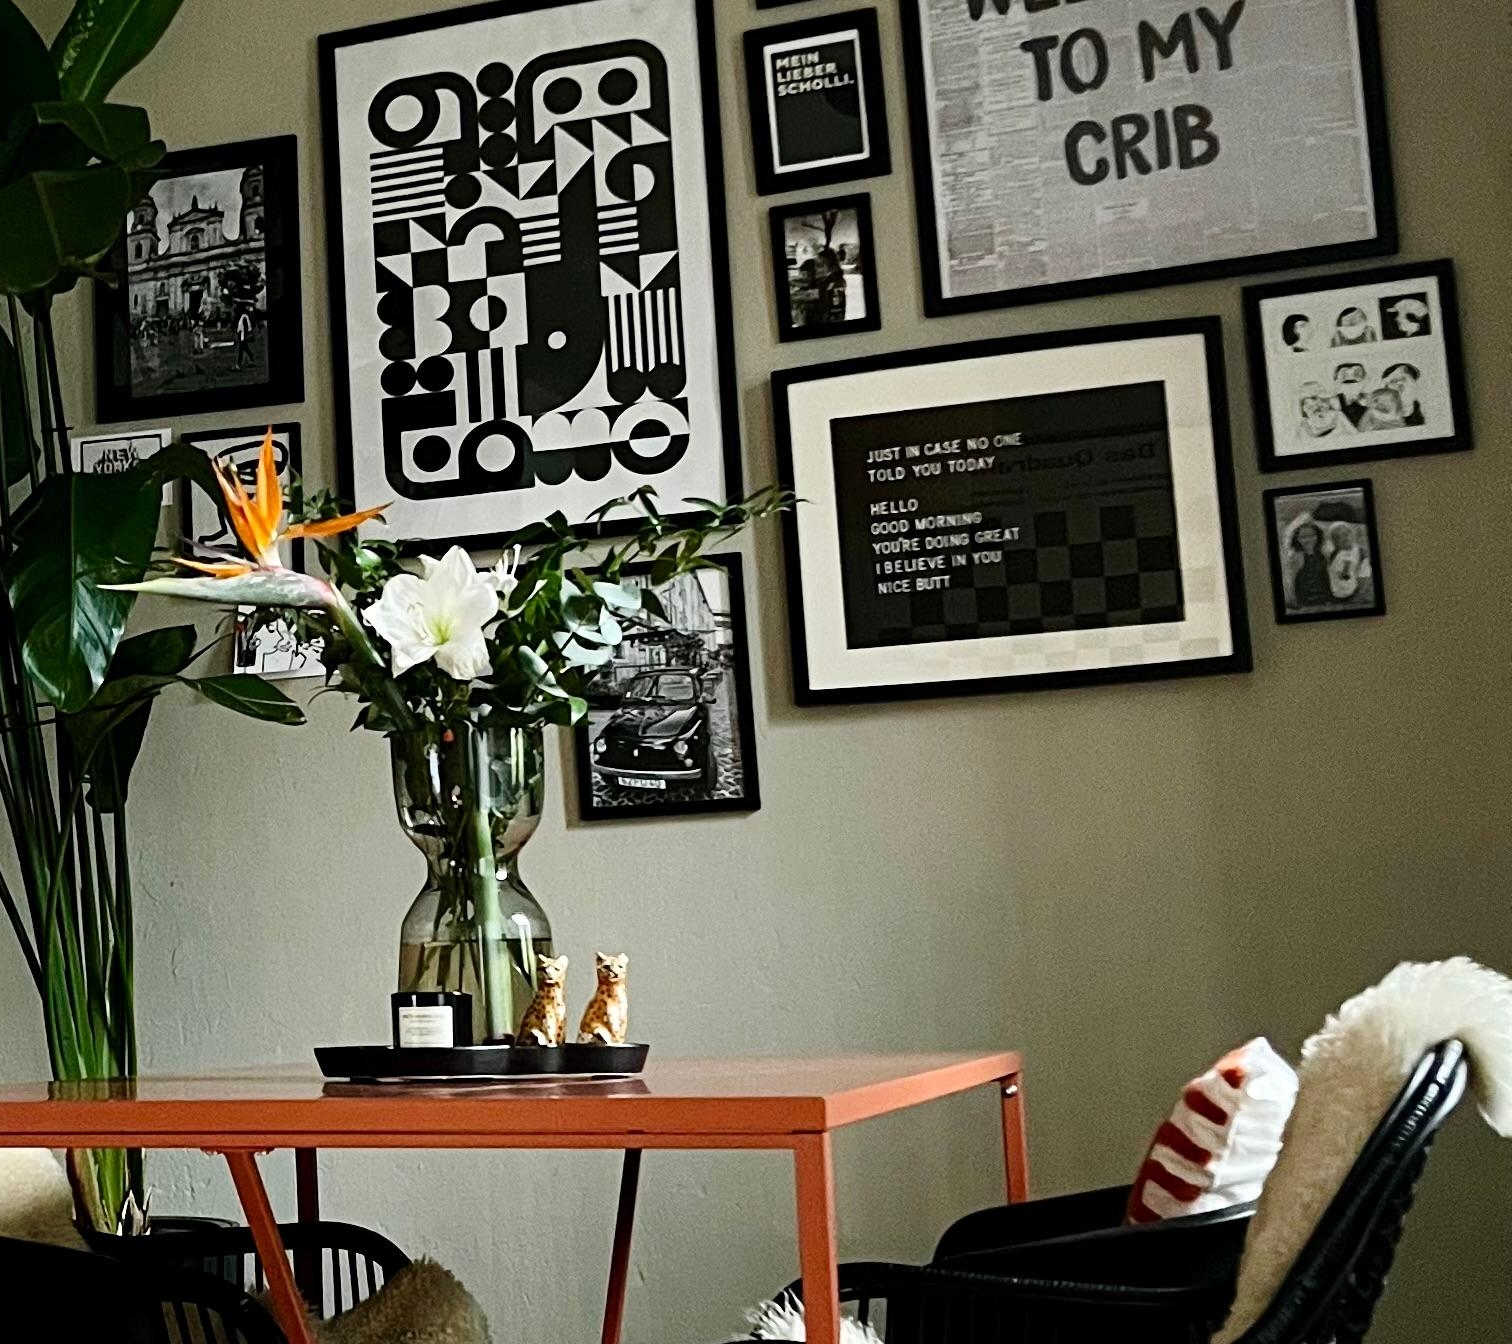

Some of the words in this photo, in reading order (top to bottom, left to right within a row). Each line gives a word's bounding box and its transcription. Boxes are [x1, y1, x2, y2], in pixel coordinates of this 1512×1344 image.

[776, 51, 820, 70] MEIN
[777, 62, 837, 83] LIEBER
[1019, 27, 1110, 102] TO
[1064, 104, 1220, 186] CRIB
[101, 442, 139, 463] NEW
[866, 446, 902, 463] JUST
[905, 445, 921, 458] IN
[924, 439, 961, 456] CASE
[966, 437, 989, 450] NO
[993, 432, 1024, 447] ONE
[867, 466, 906, 483] TOLD
[912, 462, 942, 477] YOU
[947, 456, 996, 473] TODAY
[870, 498, 919, 516] HELLO
[870, 519, 910, 535] GOOD
[914, 511, 983, 531] MORNING
[872, 536, 921, 555] YOU'RE
[925, 532, 970, 550] DOING
[974, 527, 1020, 543] GREAT
[875, 563, 881, 575] I
[883, 555, 947, 574] BELIEVE
[951, 554, 967, 567] IN
[972, 550, 1003, 564] YOU
[877, 579, 912, 595] NICE
[915, 575, 952, 591] BUTT
